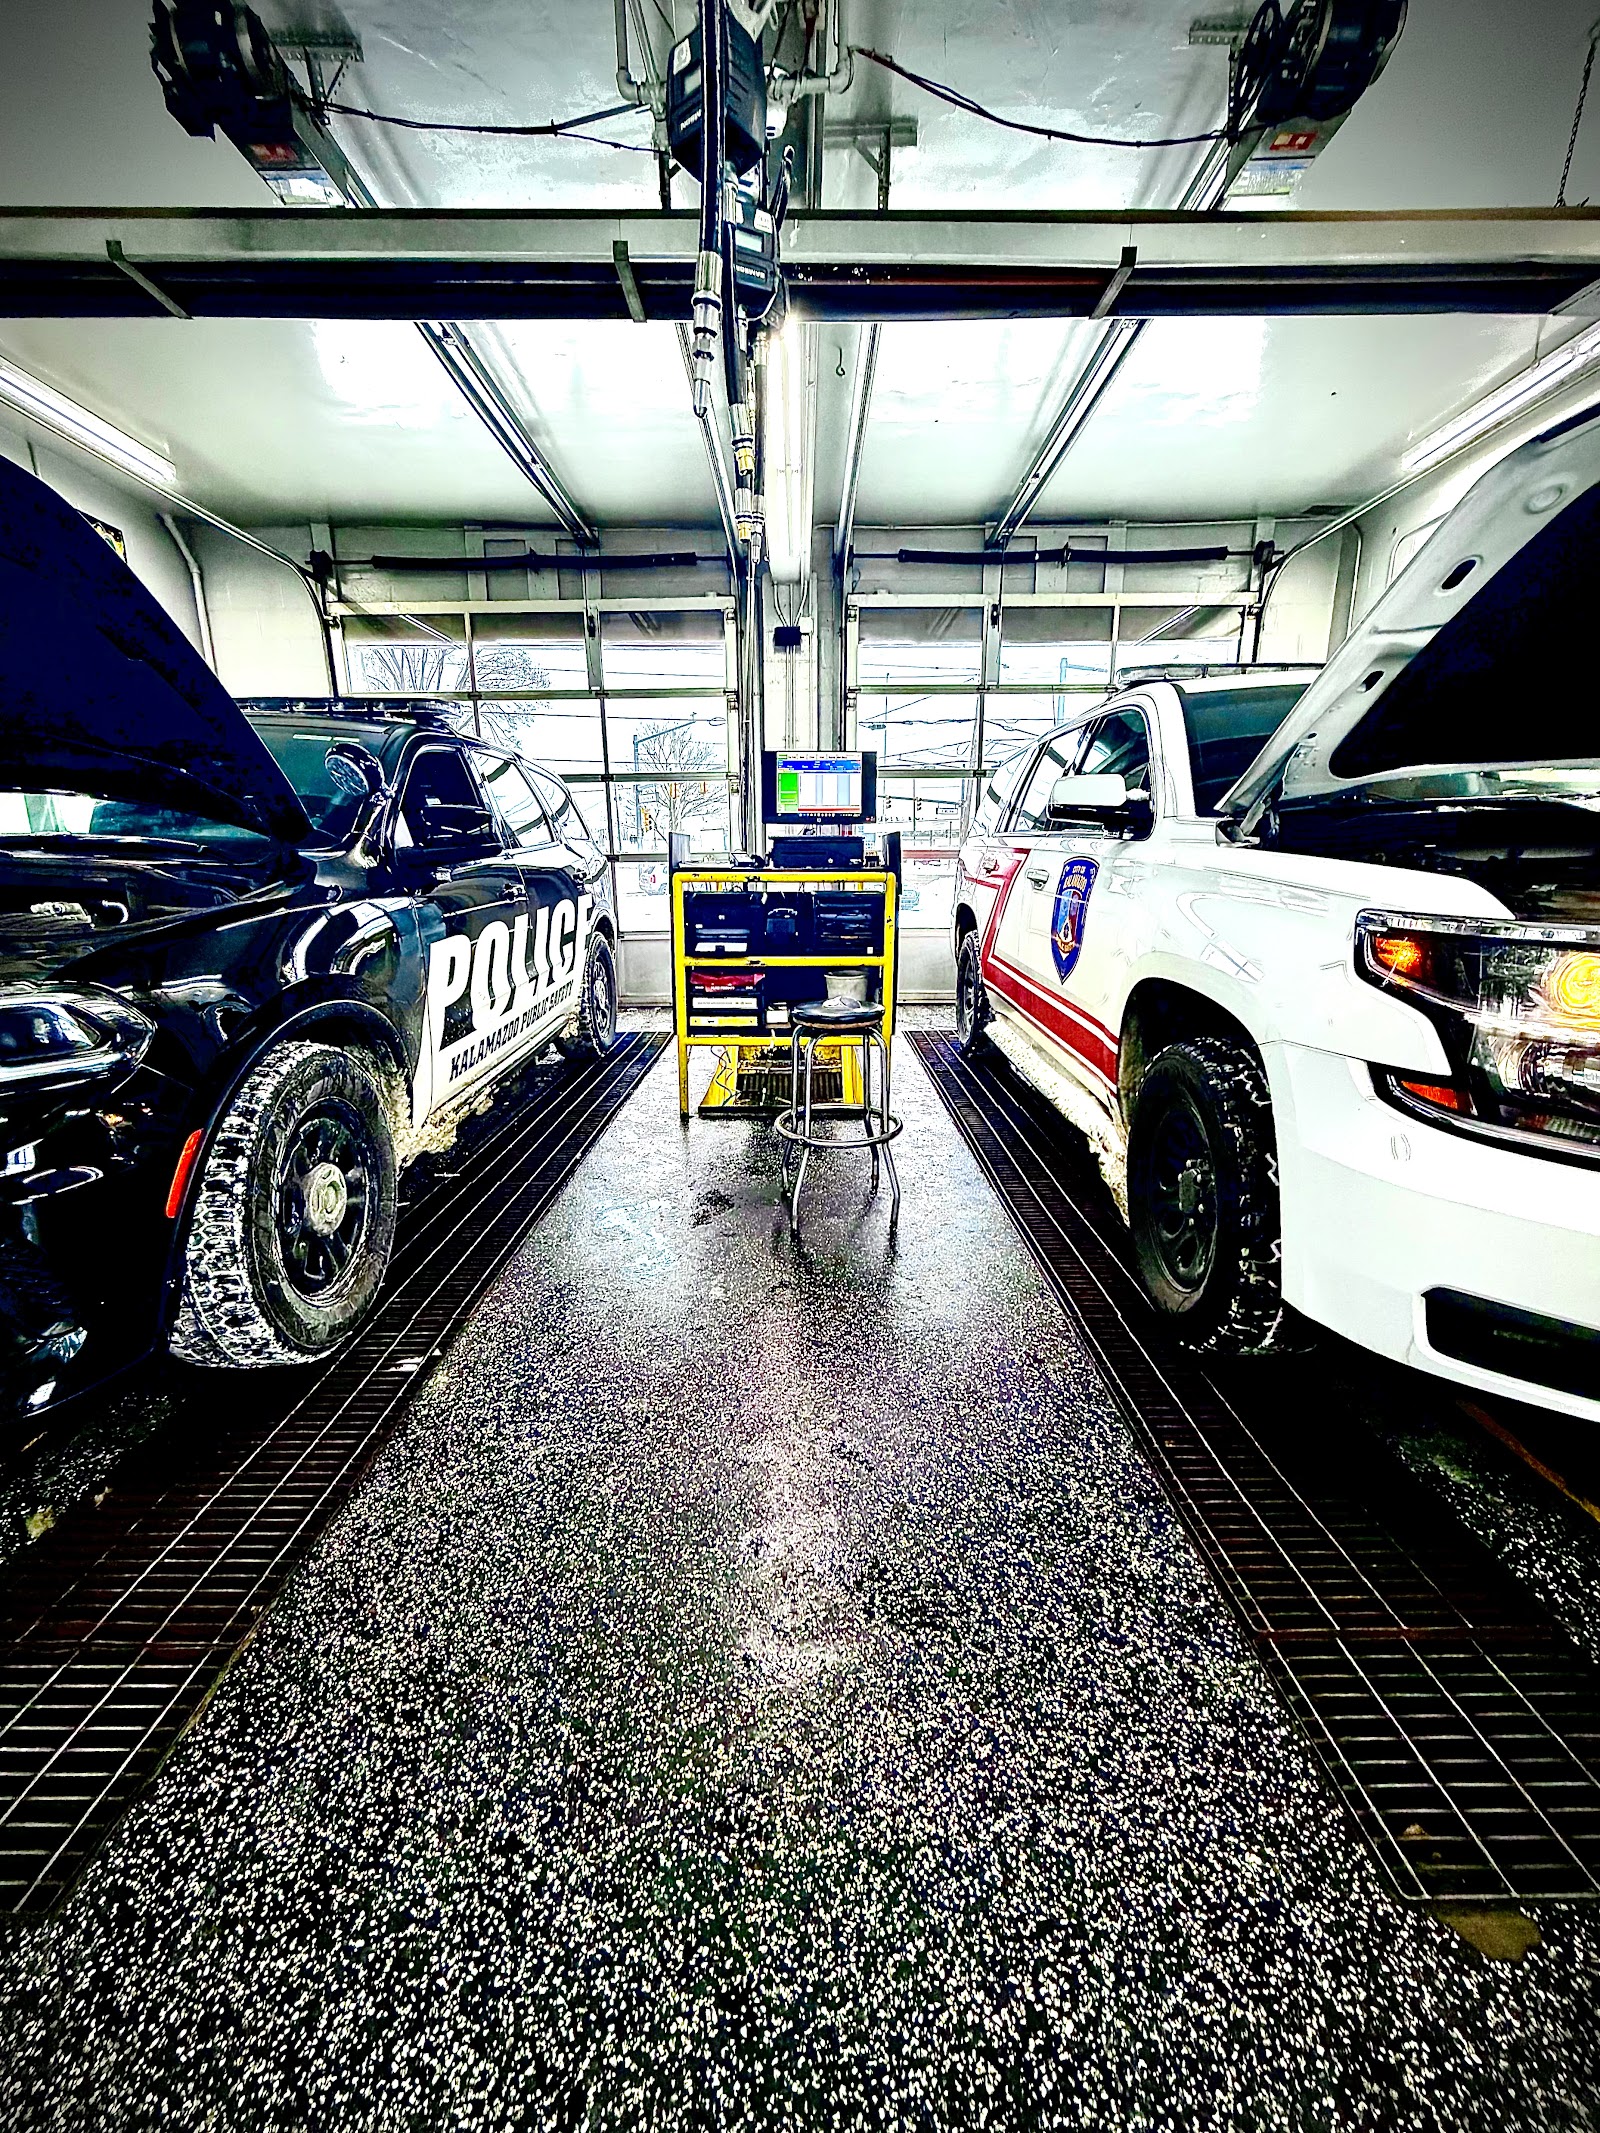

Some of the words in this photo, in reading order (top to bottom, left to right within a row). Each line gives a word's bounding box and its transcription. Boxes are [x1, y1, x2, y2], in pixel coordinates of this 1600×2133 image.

[428, 893, 594, 1044] POLICE
[449, 1016, 520, 1083] KALAMAZOO
[519, 996, 549, 1033] PUBLIC
[549, 979, 574, 1011] SAFETY
